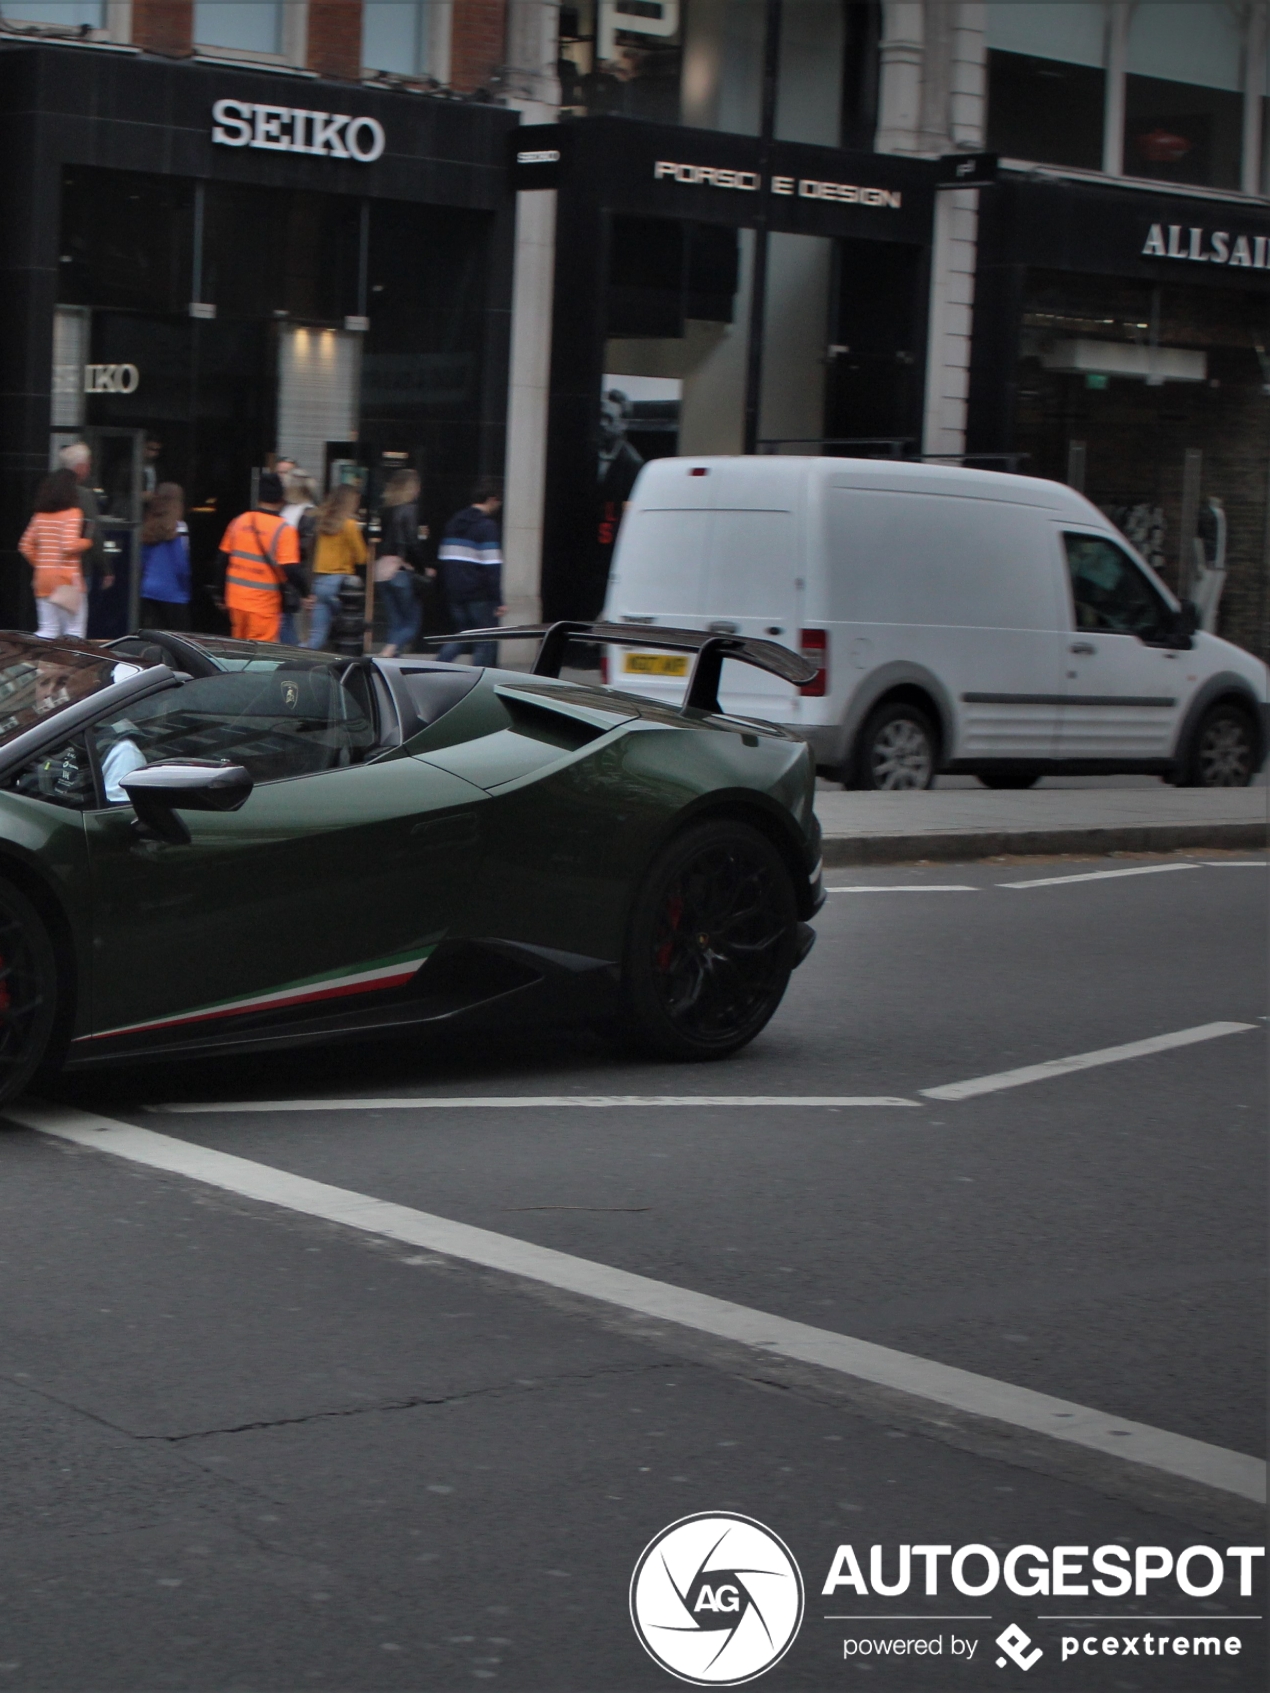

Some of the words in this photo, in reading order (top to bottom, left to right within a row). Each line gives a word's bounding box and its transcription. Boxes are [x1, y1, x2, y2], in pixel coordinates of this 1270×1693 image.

[211, 98, 386, 163] SEIKO
[654, 160, 796, 196] PORSCE
[798, 179, 902, 209] DESIGN
[1141, 222, 1270, 270] ALLSAI
